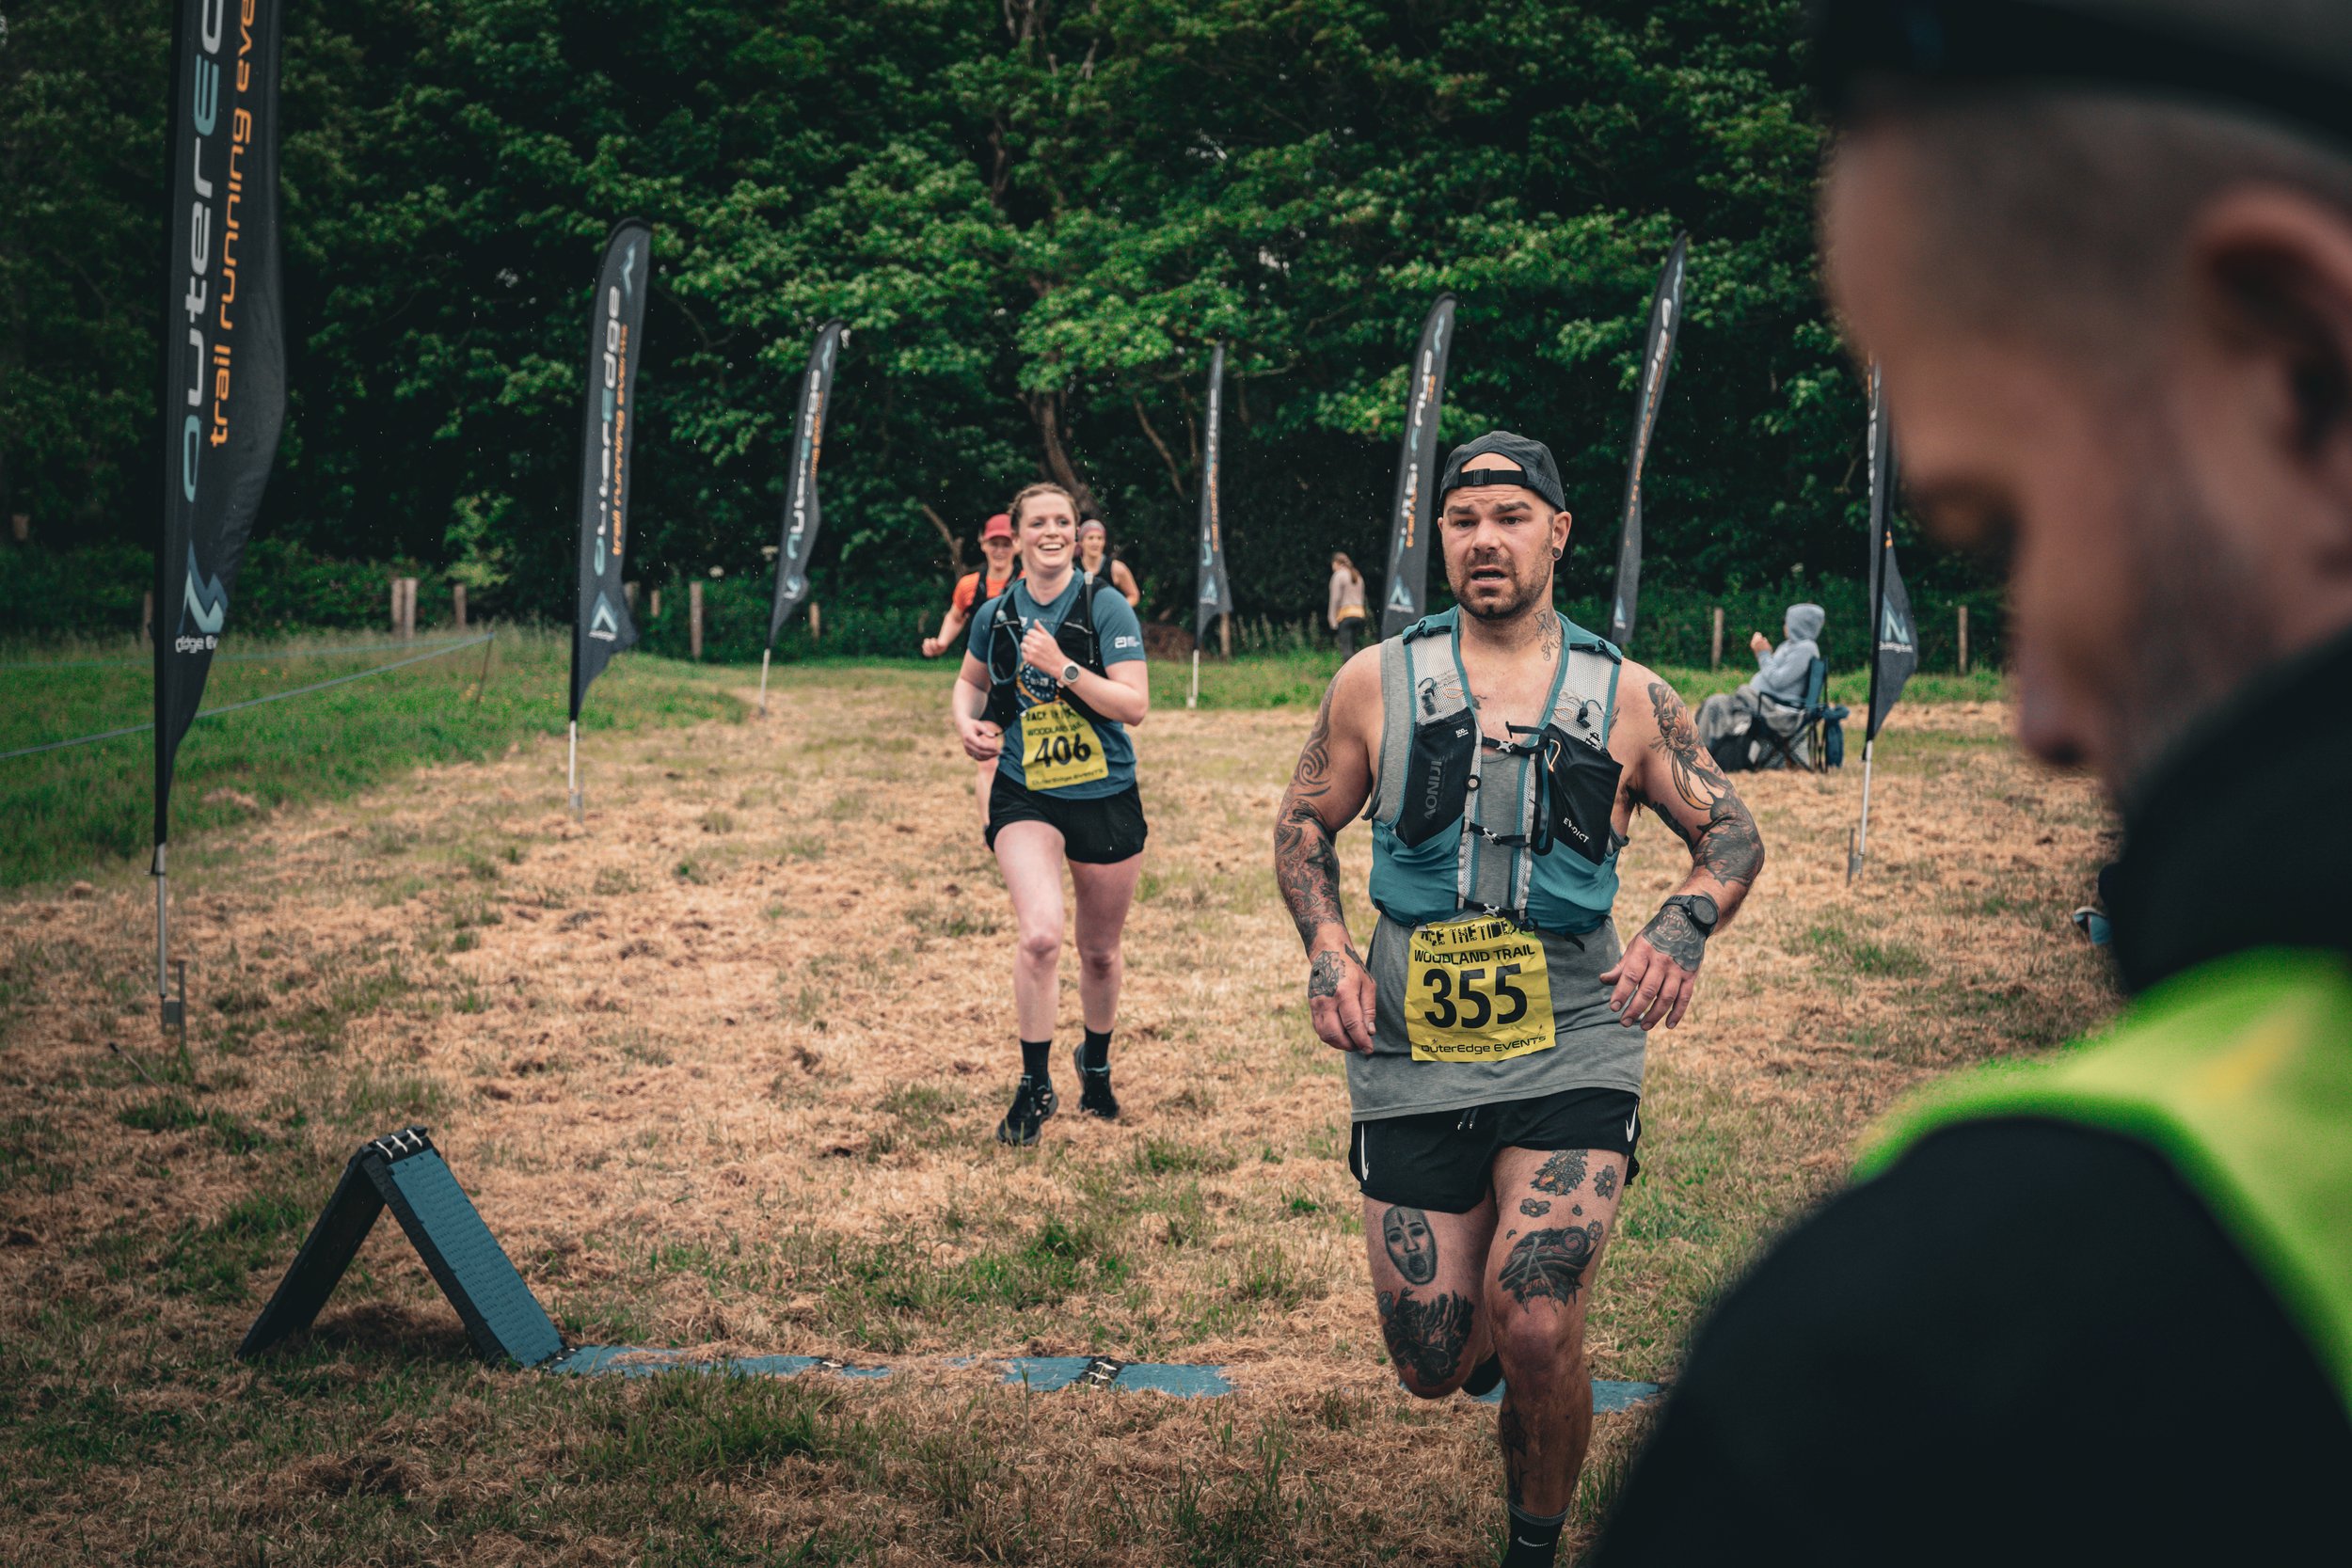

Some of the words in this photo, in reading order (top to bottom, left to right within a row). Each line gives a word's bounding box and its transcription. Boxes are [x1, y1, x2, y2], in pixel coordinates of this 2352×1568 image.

[219, 107, 252, 330] running
[210, 344, 231, 448] trail
[1034, 733, 1091, 768] 406
[1449, 924, 1477, 944] THE
[1414, 948, 1490, 965] WOODLAND
[1494, 943, 1535, 960] TRAIL
[1423, 963, 1528, 1029] 355
[1422, 1044, 1491, 1055] OuterEdge
[1493, 1035, 1547, 1052] EVENTS
